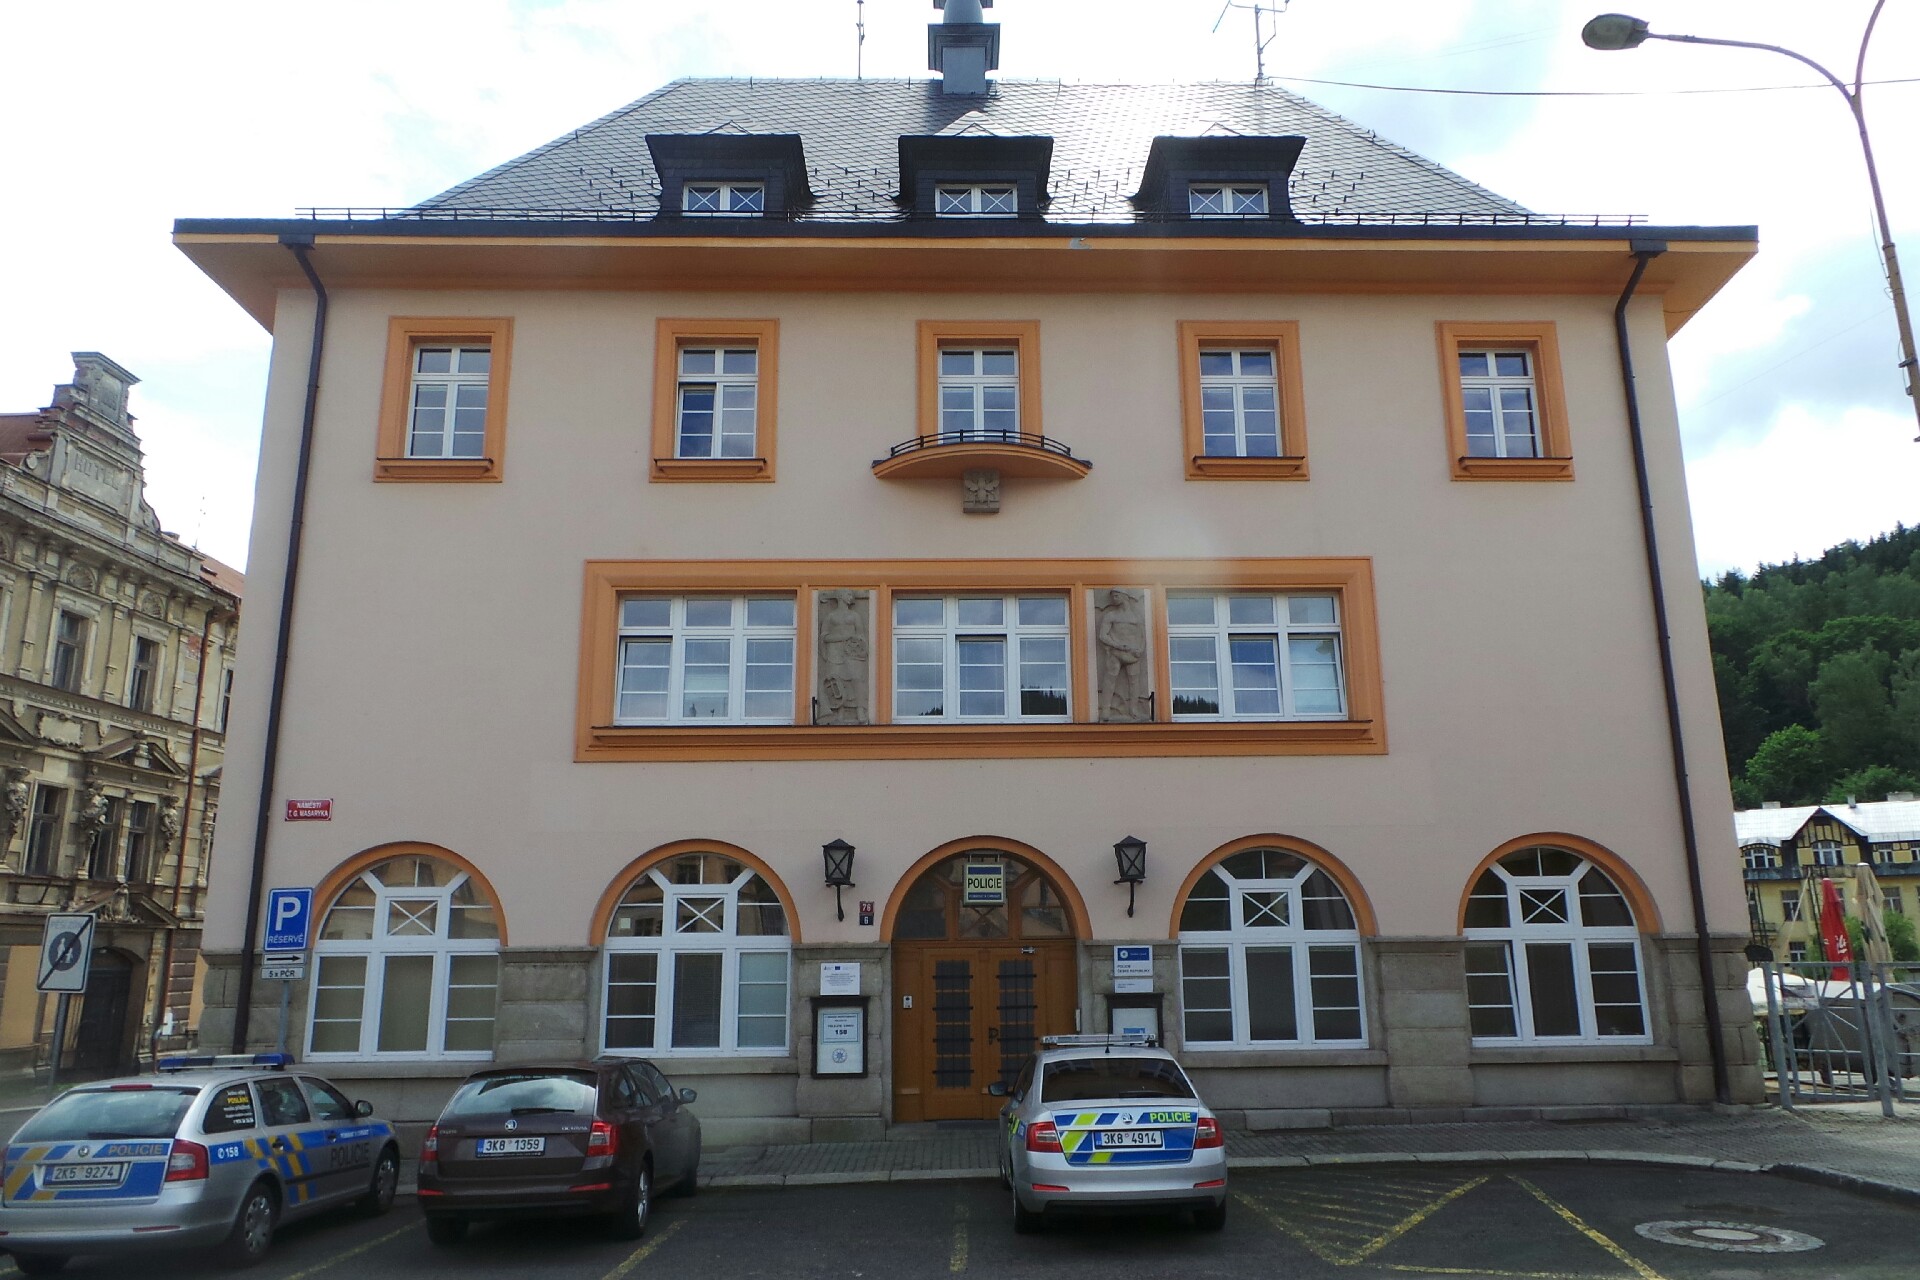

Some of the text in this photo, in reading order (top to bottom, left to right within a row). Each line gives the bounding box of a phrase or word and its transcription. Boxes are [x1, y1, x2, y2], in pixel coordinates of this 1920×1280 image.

[74, 452, 119, 491] HOTEL
[299, 809, 329, 817] MASARYKA
[967, 878, 1002, 889] POLICIE
[275, 896, 302, 931] P
[268, 932, 304, 944] RÉSERVÉ
[268, 970, 274, 978] 5
[280, 969, 295, 977] PČR
[1149, 1111, 1192, 1123] POLICIE
[1104, 1133, 1123, 1144] 3K8
[1132, 1131, 1157, 1144] 4914
[109, 1143, 164, 1156] POLICIE
[486, 1140, 505, 1151] 3K8
[514, 1139, 540, 1151] 1359
[225, 1146, 239, 1158] 158
[330, 1141, 369, 1167] POLICIE
[54, 1167, 77, 1180] 2K5
[85, 1166, 114, 1179] 9274
